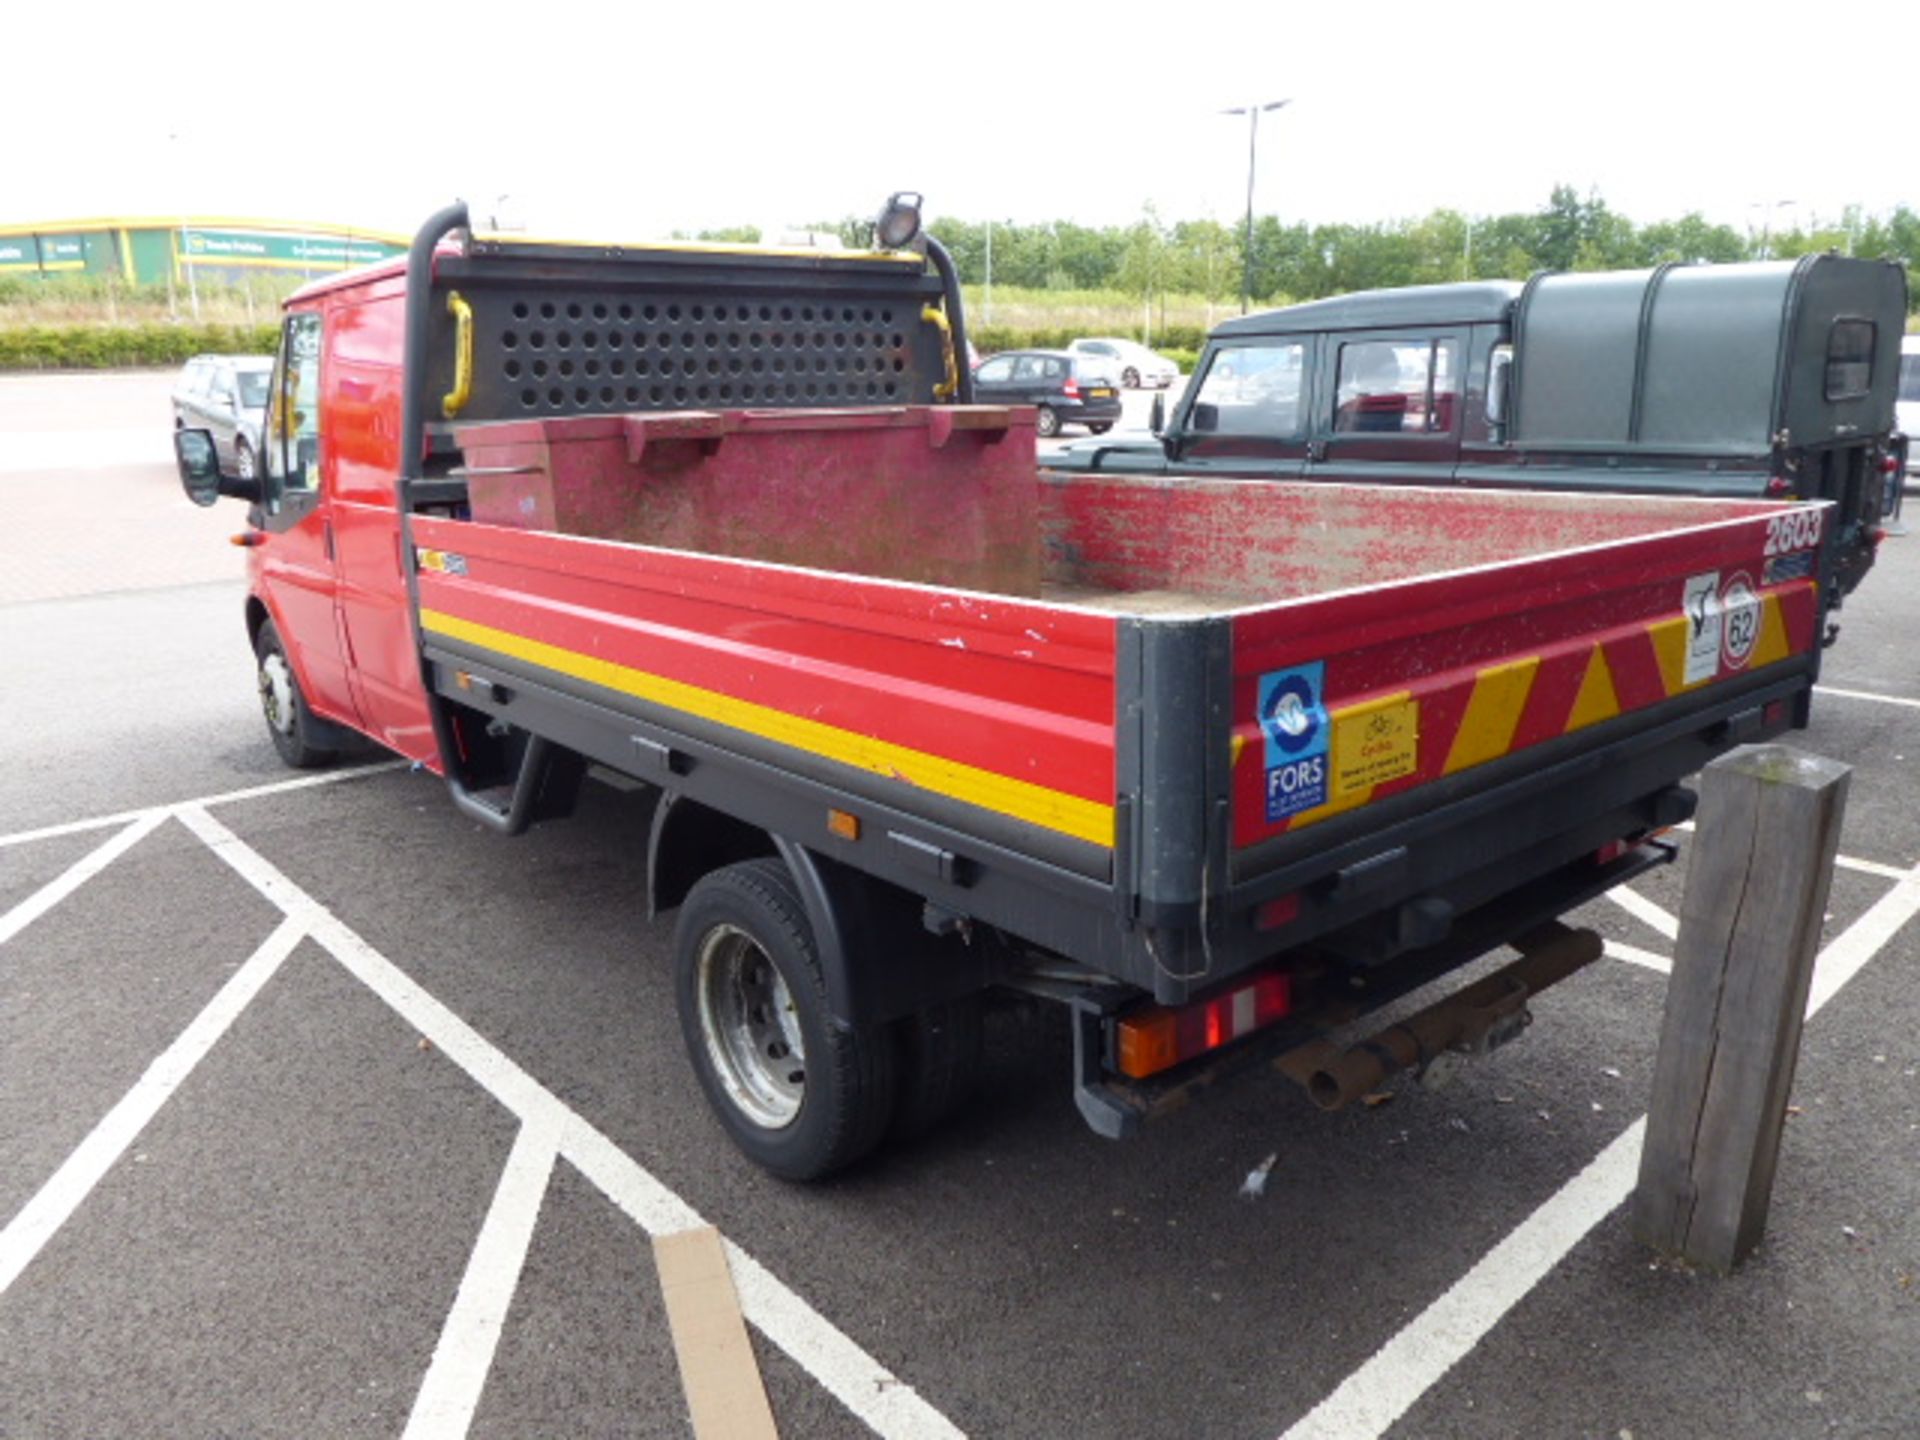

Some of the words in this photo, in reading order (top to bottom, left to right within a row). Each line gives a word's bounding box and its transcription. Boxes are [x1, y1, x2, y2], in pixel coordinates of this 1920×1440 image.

[1764, 511, 1822, 555] 2603
[1729, 611, 1753, 648] 62
[1269, 757, 1323, 797] FORS
